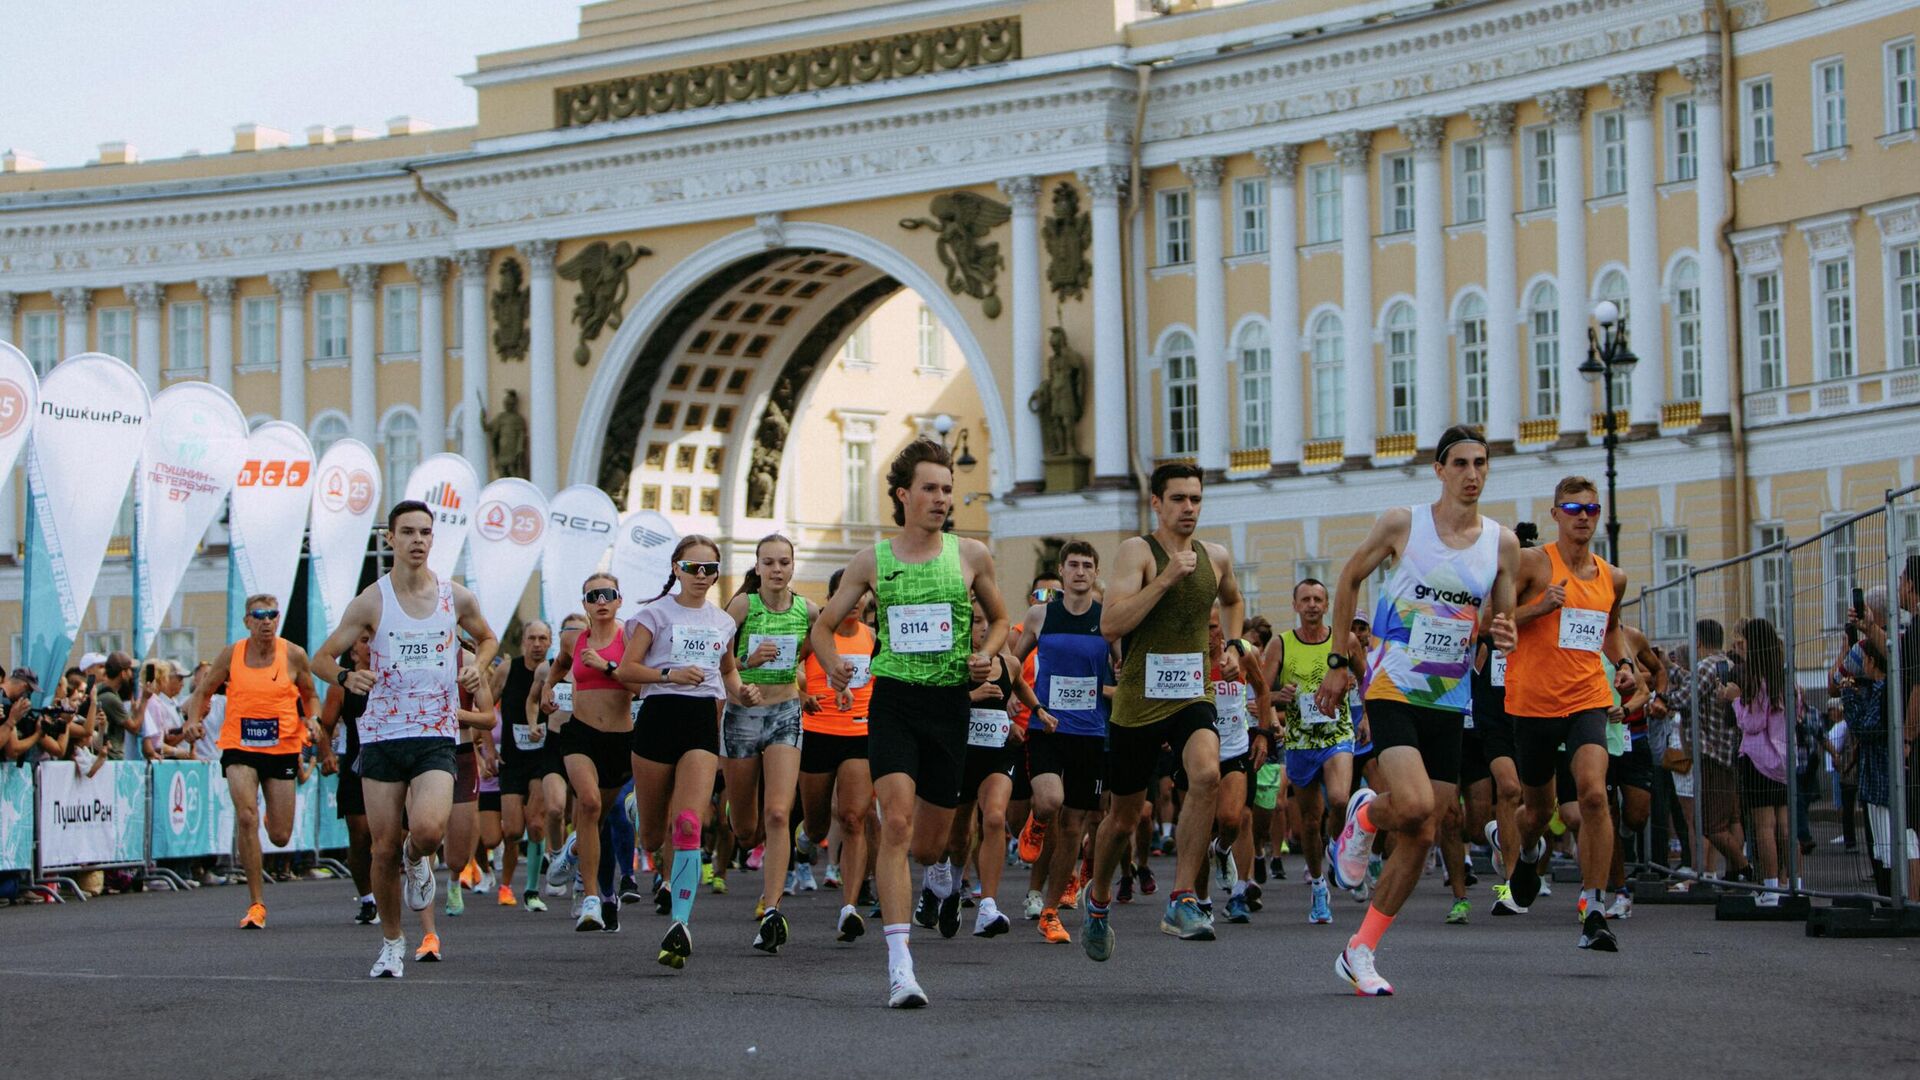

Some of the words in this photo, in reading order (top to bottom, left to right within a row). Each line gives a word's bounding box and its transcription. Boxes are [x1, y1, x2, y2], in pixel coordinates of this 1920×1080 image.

[0, 396, 16, 418] 5
[40, 401, 143, 425] ПушкинРан
[168, 488, 191, 503] 97
[351, 481, 370, 499] 25
[515, 515, 536, 531] 25
[550, 511, 611, 534] RED
[1415, 584, 1482, 608] gryadka
[900, 621, 929, 635] 8114
[1569, 622, 1596, 636] 7344
[683, 639, 706, 651] 7616
[1424, 632, 1452, 647] 7172
[399, 643, 429, 655] 7735
[1156, 669, 1187, 682] 7872
[1057, 688, 1083, 698] 7532
[1217, 681, 1238, 697] SIA
[558, 693, 573, 701] 812
[1307, 703, 1319, 713] 76
[246, 727, 269, 737] 11189
[969, 721, 997, 733] 7090
